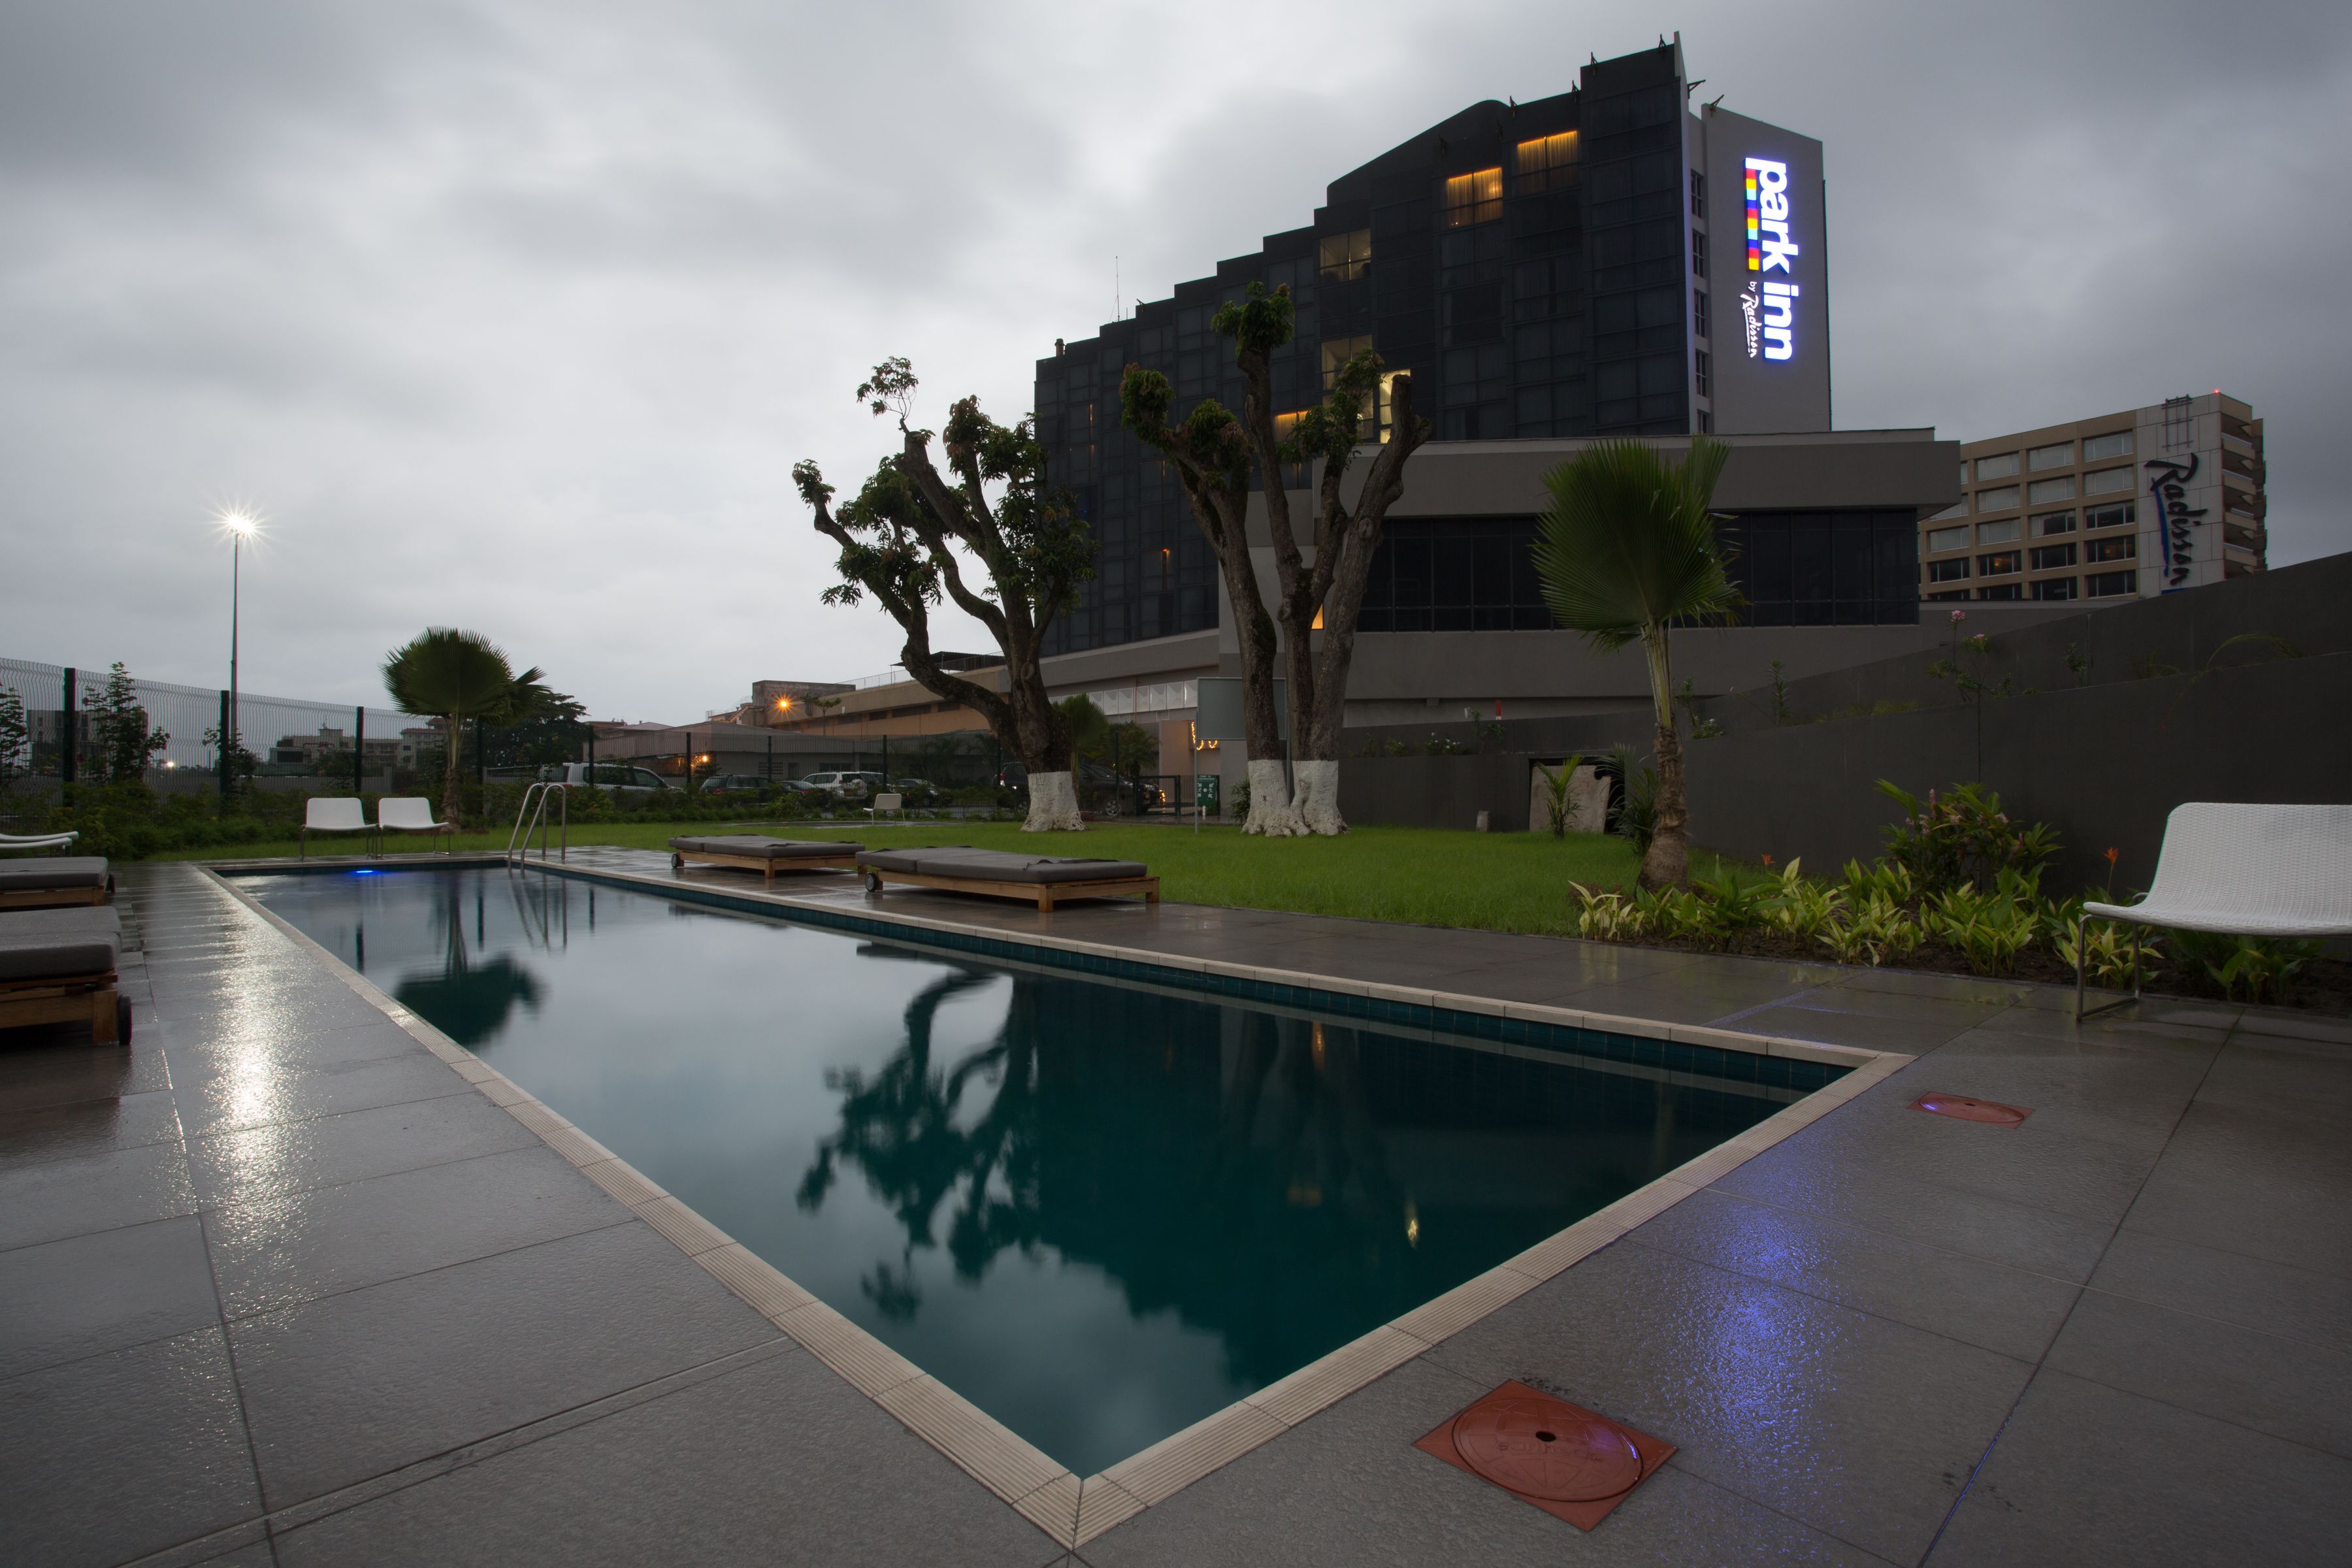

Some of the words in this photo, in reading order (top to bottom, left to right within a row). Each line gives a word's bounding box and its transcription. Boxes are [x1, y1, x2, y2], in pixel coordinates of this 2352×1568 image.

[1744, 157, 1799, 274] park
[1740, 293, 1763, 358] Radisson
[1748, 281, 1757, 293] by
[1763, 282, 1799, 361] inn
[2144, 452, 2208, 586] Radisson
